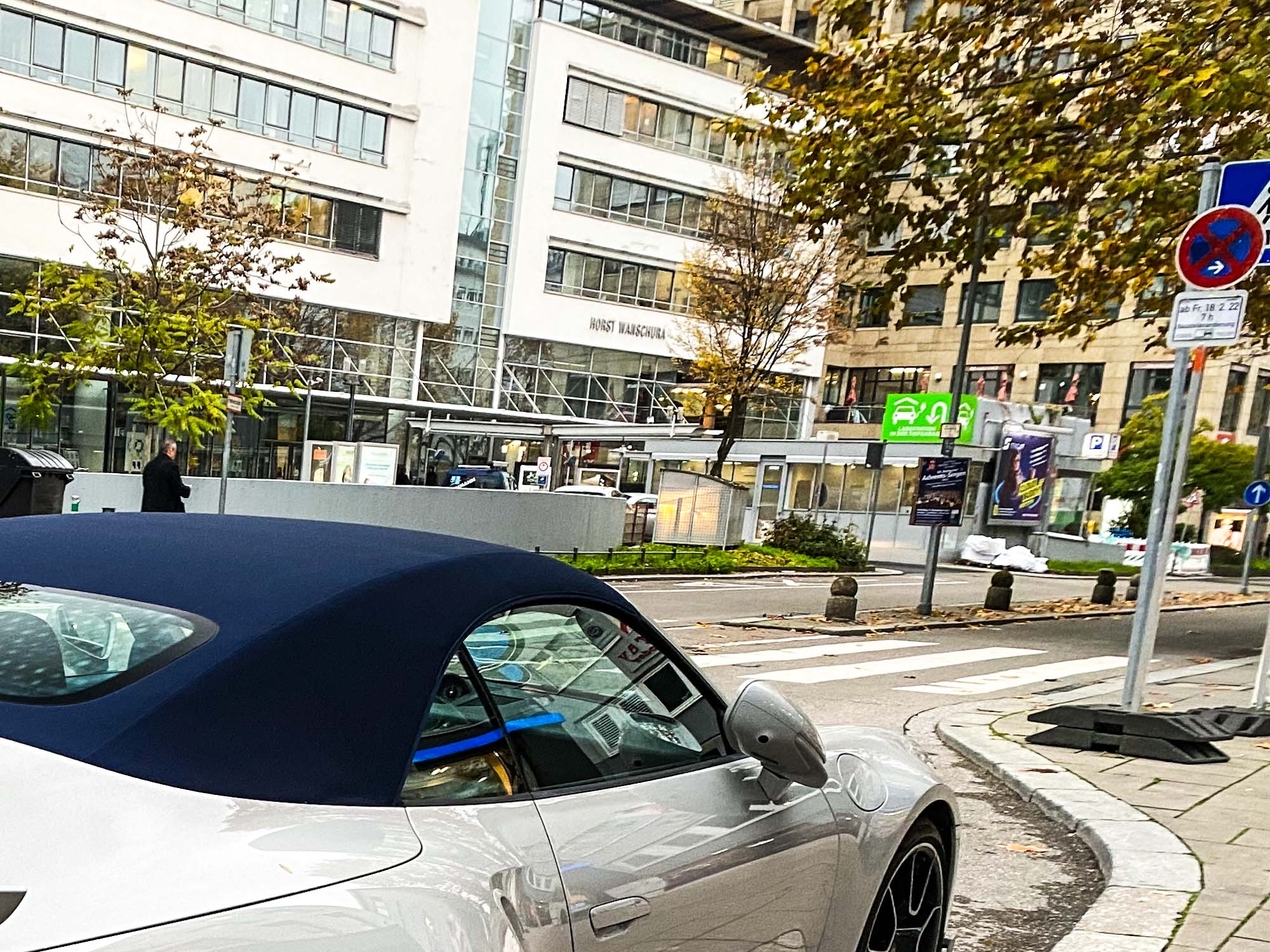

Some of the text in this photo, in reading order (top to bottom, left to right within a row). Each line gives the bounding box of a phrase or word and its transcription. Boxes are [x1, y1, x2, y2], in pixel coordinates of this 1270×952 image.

[1228, 302, 1239, 311] 22
[589, 317, 666, 340] HORST WANSCHURA
[1090, 436, 1103, 449] P
